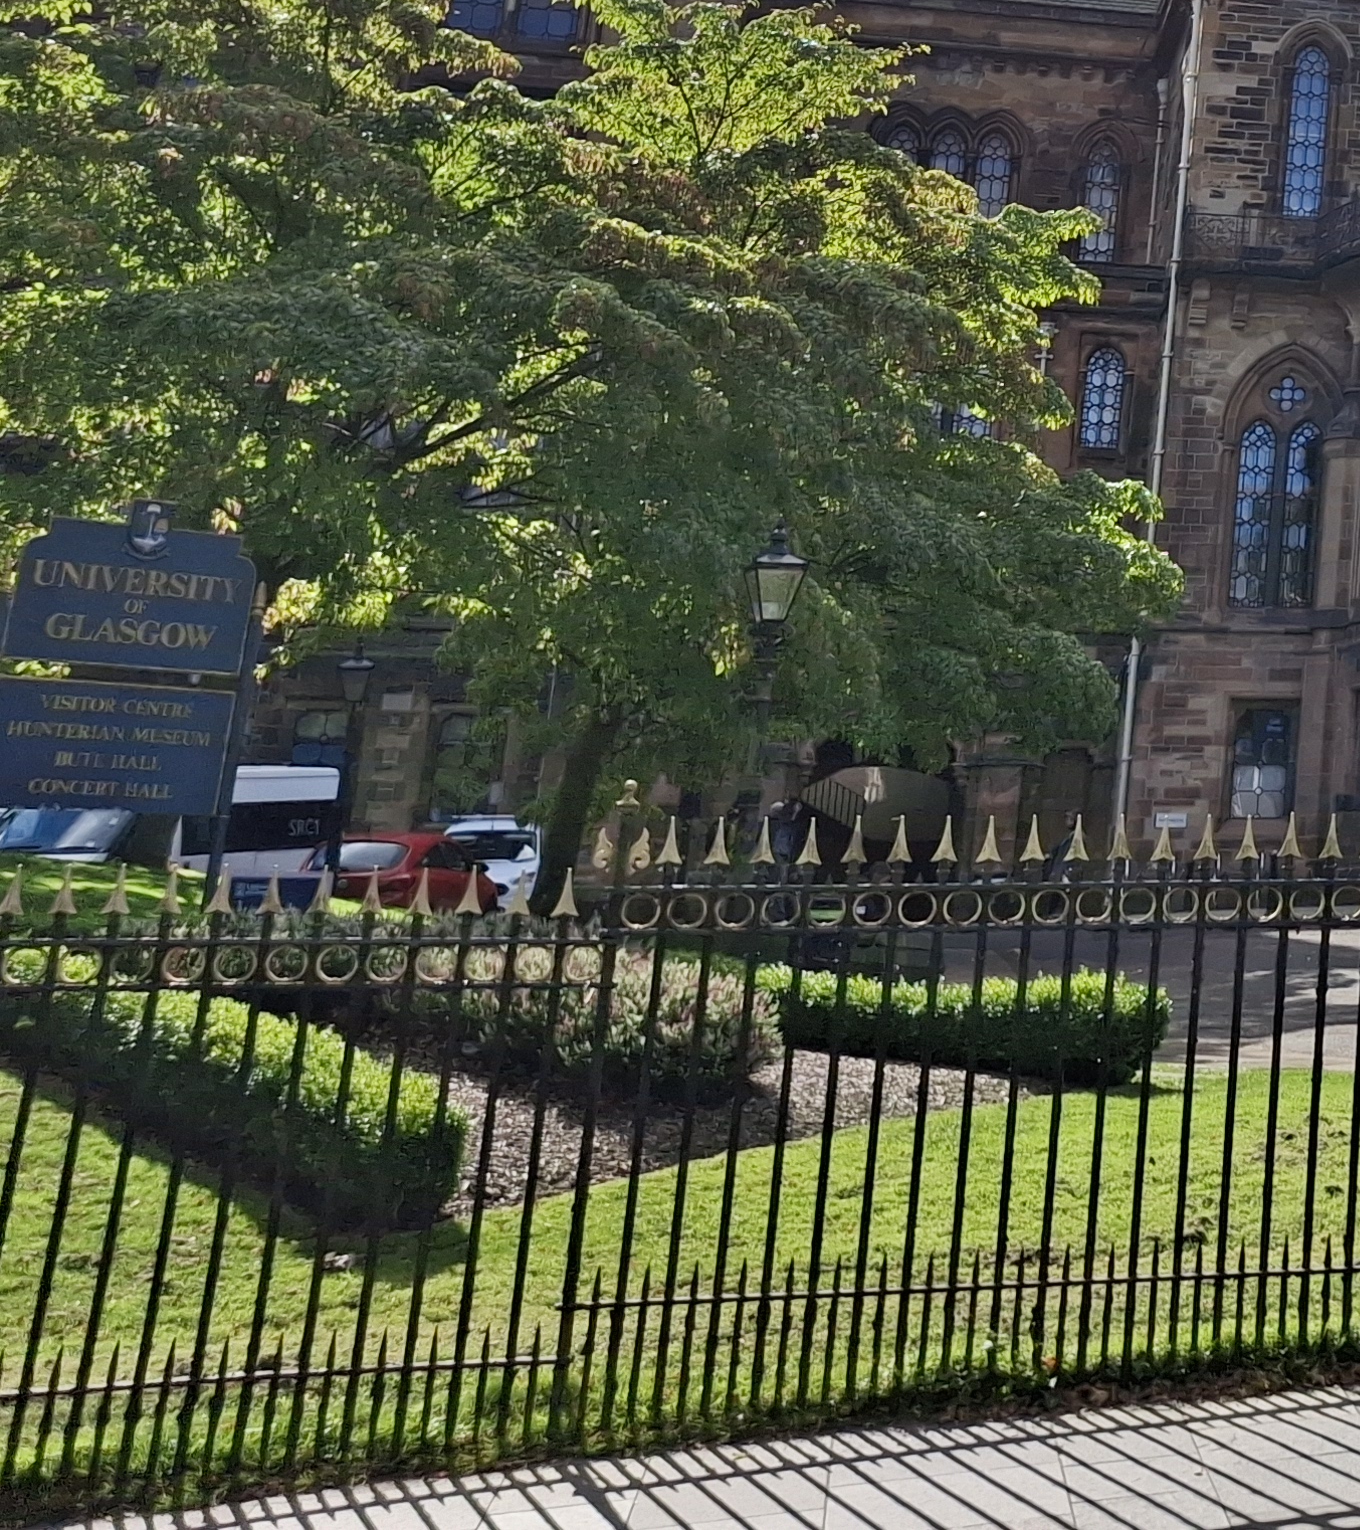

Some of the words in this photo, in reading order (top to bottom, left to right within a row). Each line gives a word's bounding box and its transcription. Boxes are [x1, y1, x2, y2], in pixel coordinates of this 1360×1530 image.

[33, 558, 242, 604] UNIVERSITY
[124, 598, 149, 615] OF
[44, 612, 219, 651] GLASGOW
[41, 693, 116, 714] VISITOR
[122, 699, 195, 719] CENTRE
[6, 720, 125, 741] HUNTERIAN
[131, 727, 211, 747] MUSEUM
[110, 753, 163, 771] HALL
[27, 777, 120, 797] CONCERT
[124, 782, 174, 800] HALL
